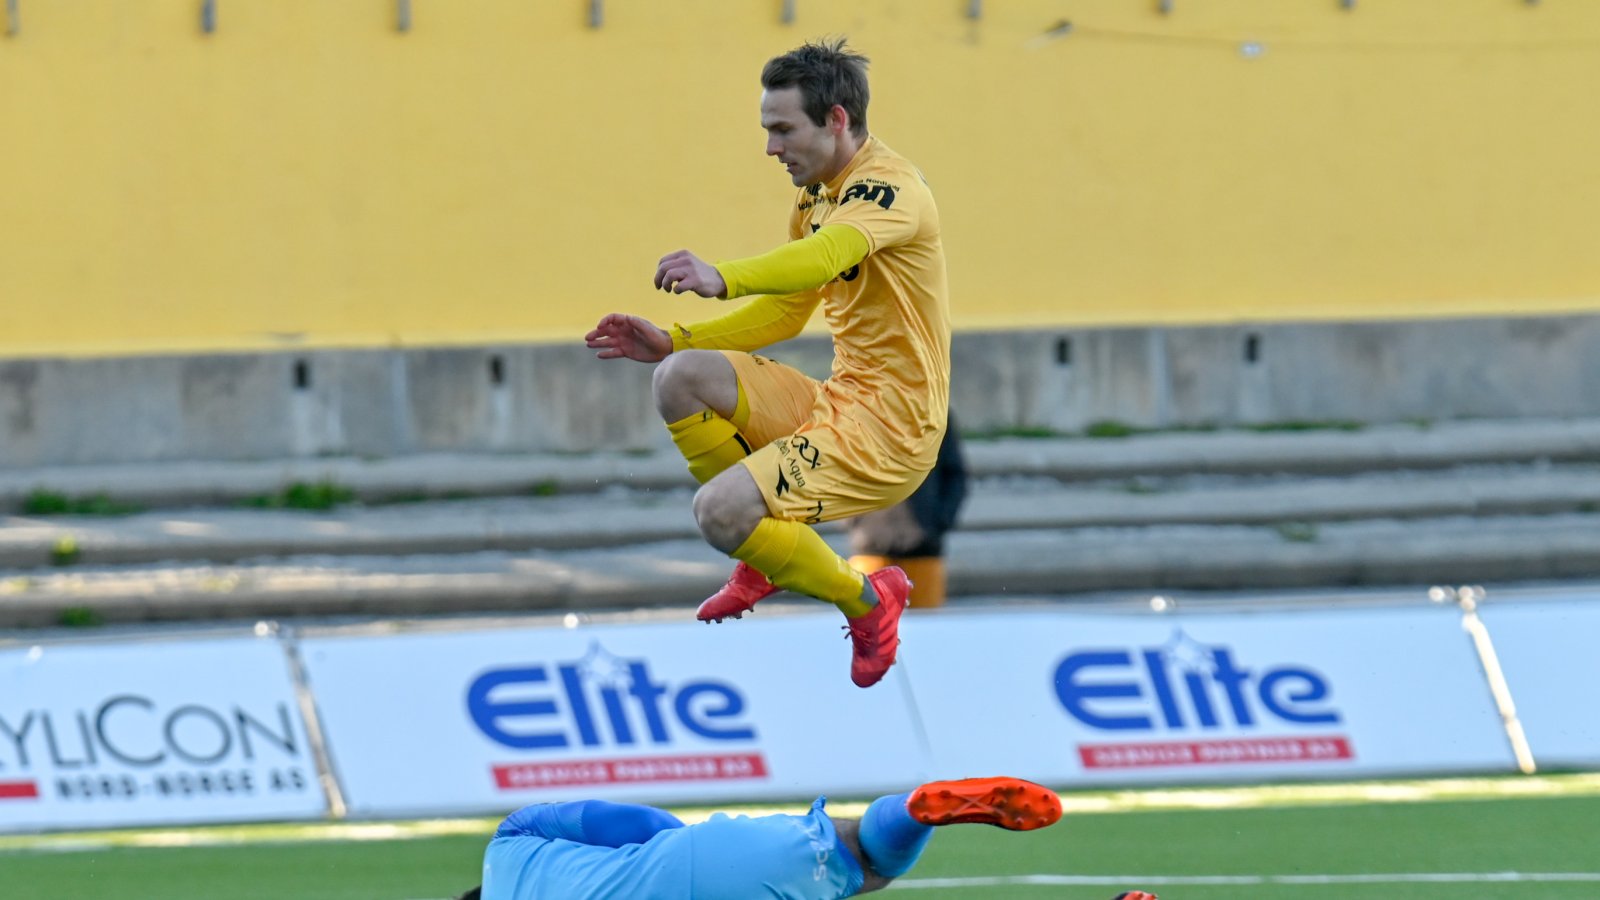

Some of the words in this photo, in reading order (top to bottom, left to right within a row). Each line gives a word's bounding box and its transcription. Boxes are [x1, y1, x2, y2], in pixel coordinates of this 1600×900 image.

[787, 457, 806, 488] Aqua
[466, 660, 757, 749] Elite
[1053, 645, 1342, 730] Elite
[0, 694, 299, 767] YLICON
